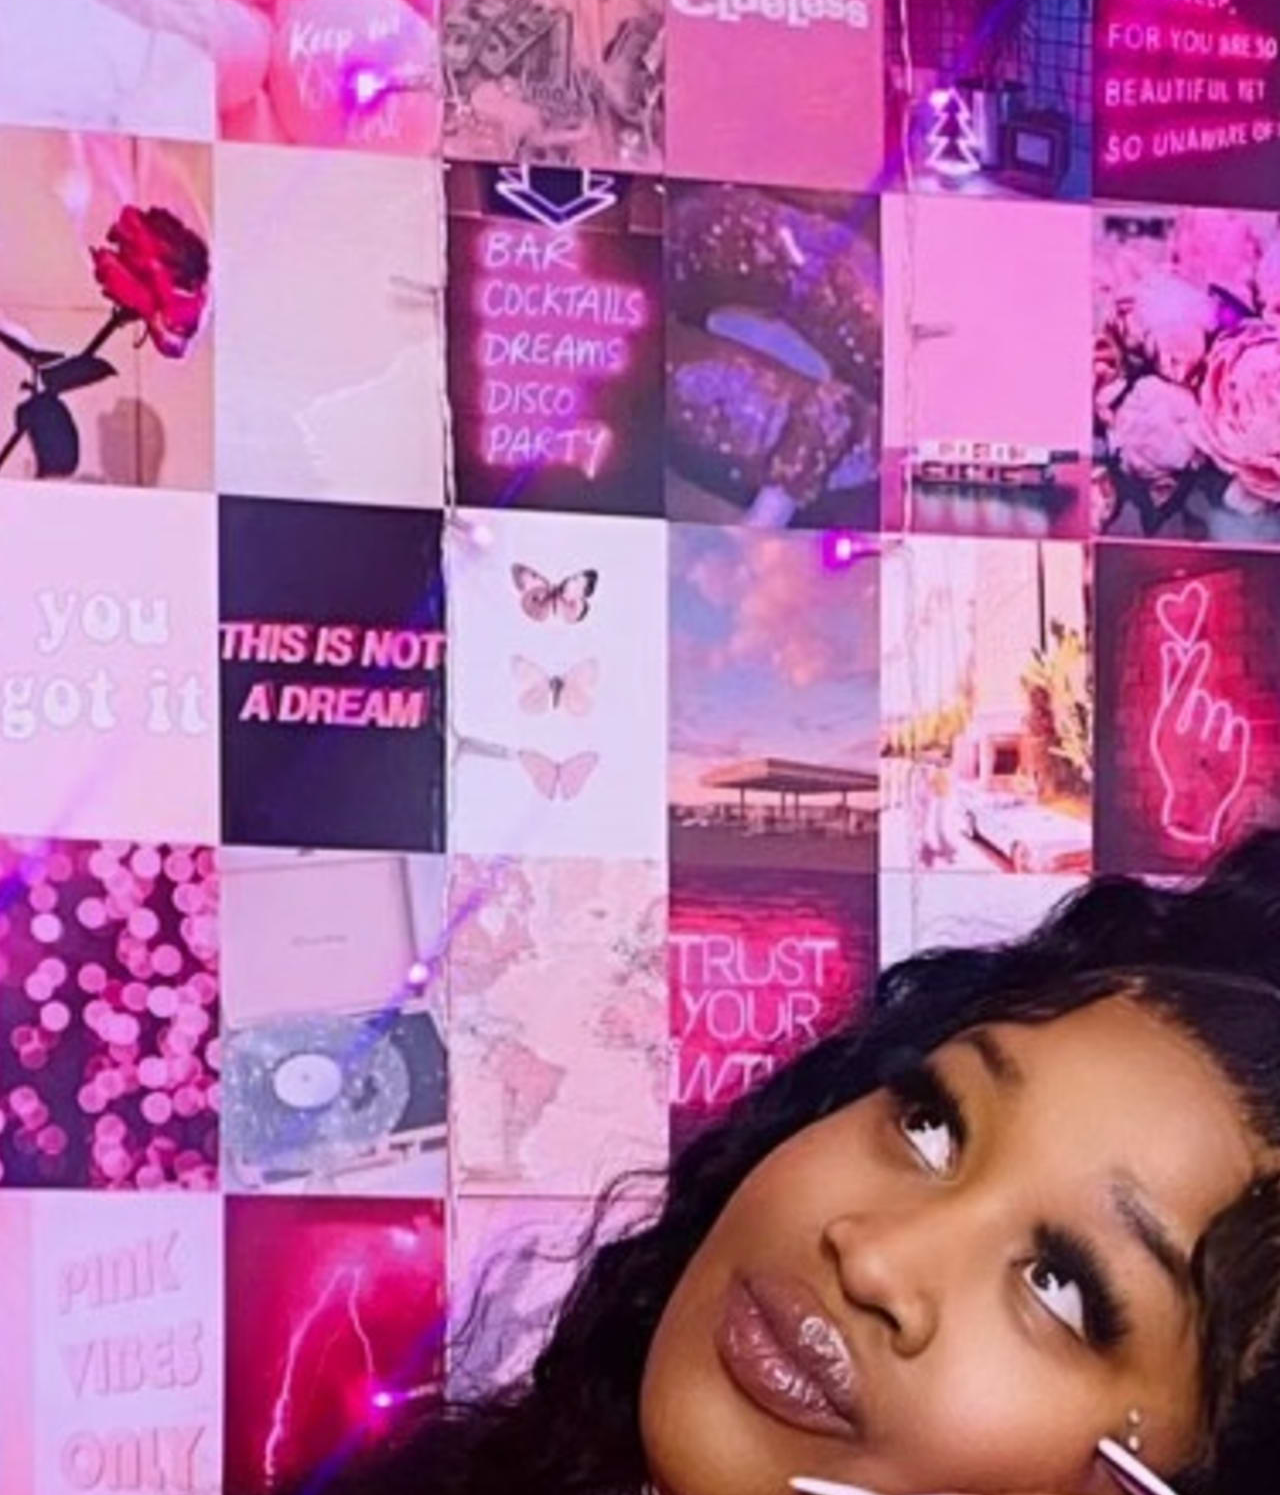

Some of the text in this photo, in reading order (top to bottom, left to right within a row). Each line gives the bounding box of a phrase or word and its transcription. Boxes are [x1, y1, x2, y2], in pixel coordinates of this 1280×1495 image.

[1108, 22, 1161, 50] FOR
[1169, 29, 1214, 54] YOU
[1105, 78, 1229, 108] BEAUTIFUL
[1105, 134, 1144, 166] SO
[485, 230, 578, 273] BAR
[483, 278, 646, 329] COCKTAILS
[486, 379, 576, 415] DISCO
[487, 420, 613, 480] PARTY
[37, 586, 170, 656] you
[218, 622, 445, 672] THIS IS NOT
[0, 666, 210, 745] got it
[240, 686, 426, 731] A DREAM
[670, 933, 839, 987] TRUST
[680, 989, 821, 1042] YOUR
[59, 1229, 183, 1317] PINK
[61, 1318, 204, 1398] VIBES
[60, 1430, 206, 1495] ONLY
